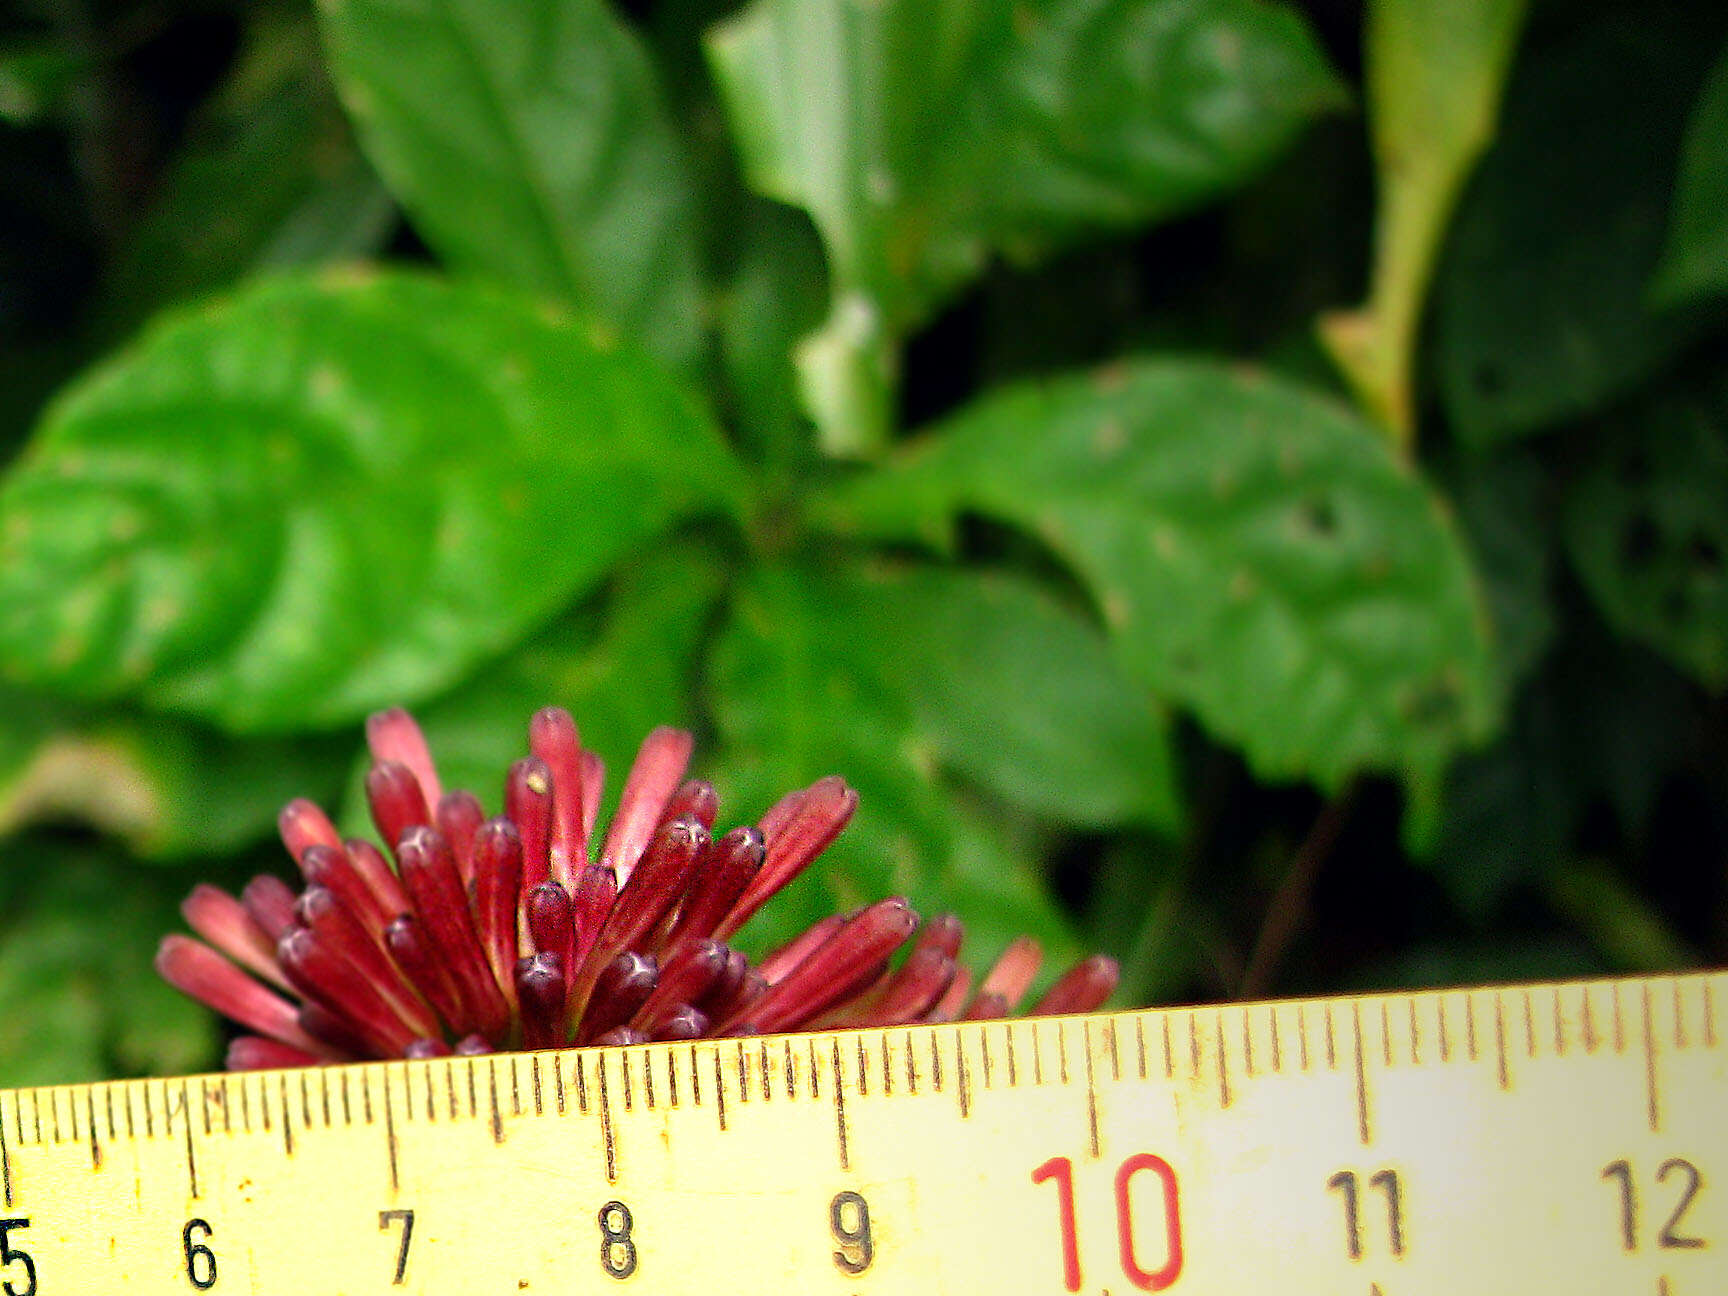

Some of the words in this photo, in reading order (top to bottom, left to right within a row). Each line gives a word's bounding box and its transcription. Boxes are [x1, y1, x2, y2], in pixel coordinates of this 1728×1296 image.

[182, 1217, 218, 1291] 6
[378, 1209, 415, 1285] 7
[599, 1200, 636, 1281] 8
[829, 1191, 875, 1276] 9
[1031, 1153, 1183, 1294] 10
[1327, 1168, 1405, 1261] 11
[1601, 1156, 1705, 1251] 12
